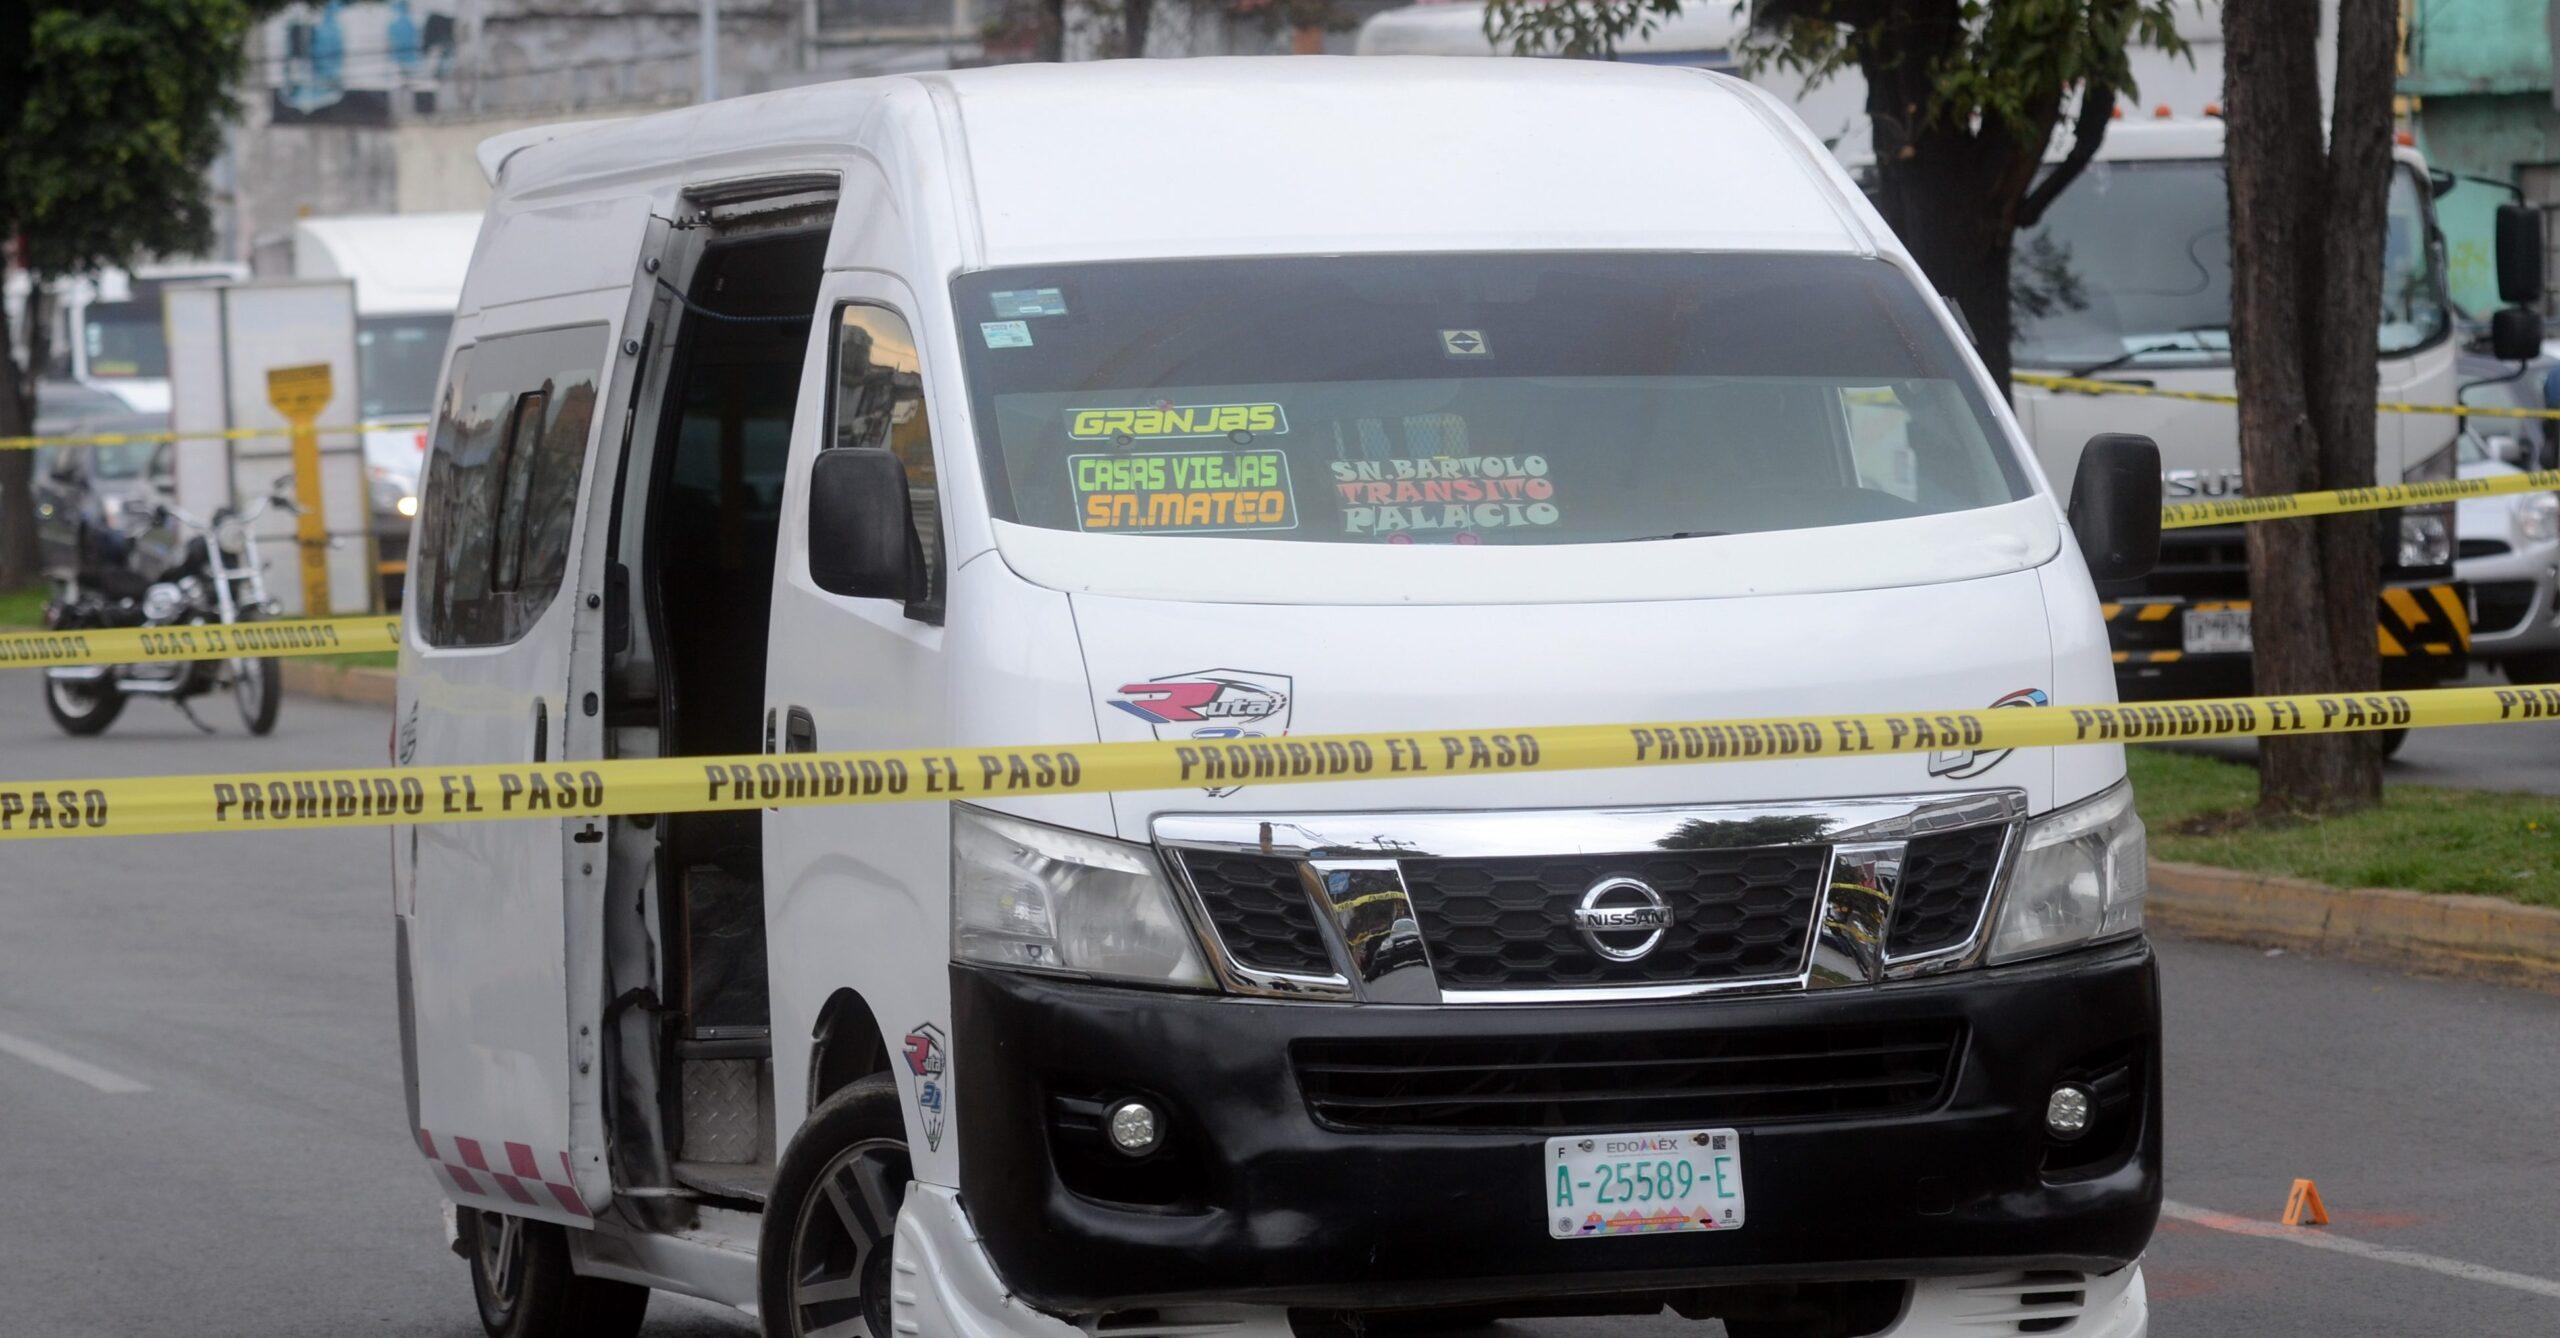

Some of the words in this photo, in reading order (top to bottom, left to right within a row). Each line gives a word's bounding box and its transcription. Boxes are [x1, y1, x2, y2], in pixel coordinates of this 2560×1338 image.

[1078, 458, 1166, 491] CASAS
[1172, 455, 1278, 489] VIEJAS
[1331, 456, 1548, 482] SN.BARTOLO
[1337, 478, 1554, 504] TRANSITO
[1343, 502, 1559, 533] PALACIO
[1630, 722, 1822, 760] PROHIBIDO
[1832, 720, 1874, 750] EL
[1885, 715, 1983, 749] PASO
[2071, 702, 2256, 739] PROHIBIDO
[2266, 700, 2306, 730] EL
[2317, 696, 2412, 728] PASO
[704, 758, 908, 801] PROHIBIDO
[921, 757, 965, 792] EL
[978, 752, 1081, 791] PASO
[1175, 740, 1373, 780] PROHIBIDO
[1384, 738, 1427, 771] EL
[1439, 734, 1540, 769] PASO
[0, 788, 108, 830] PASO
[213, 776, 424, 822] PROHIBIDO
[440, 774, 484, 813] EL
[499, 770, 604, 811] PASO
[1587, 912, 1665, 926] NISSAN
[1558, 1147, 1566, 1159] F
[1556, 1156, 1736, 1207] A-25589-E
